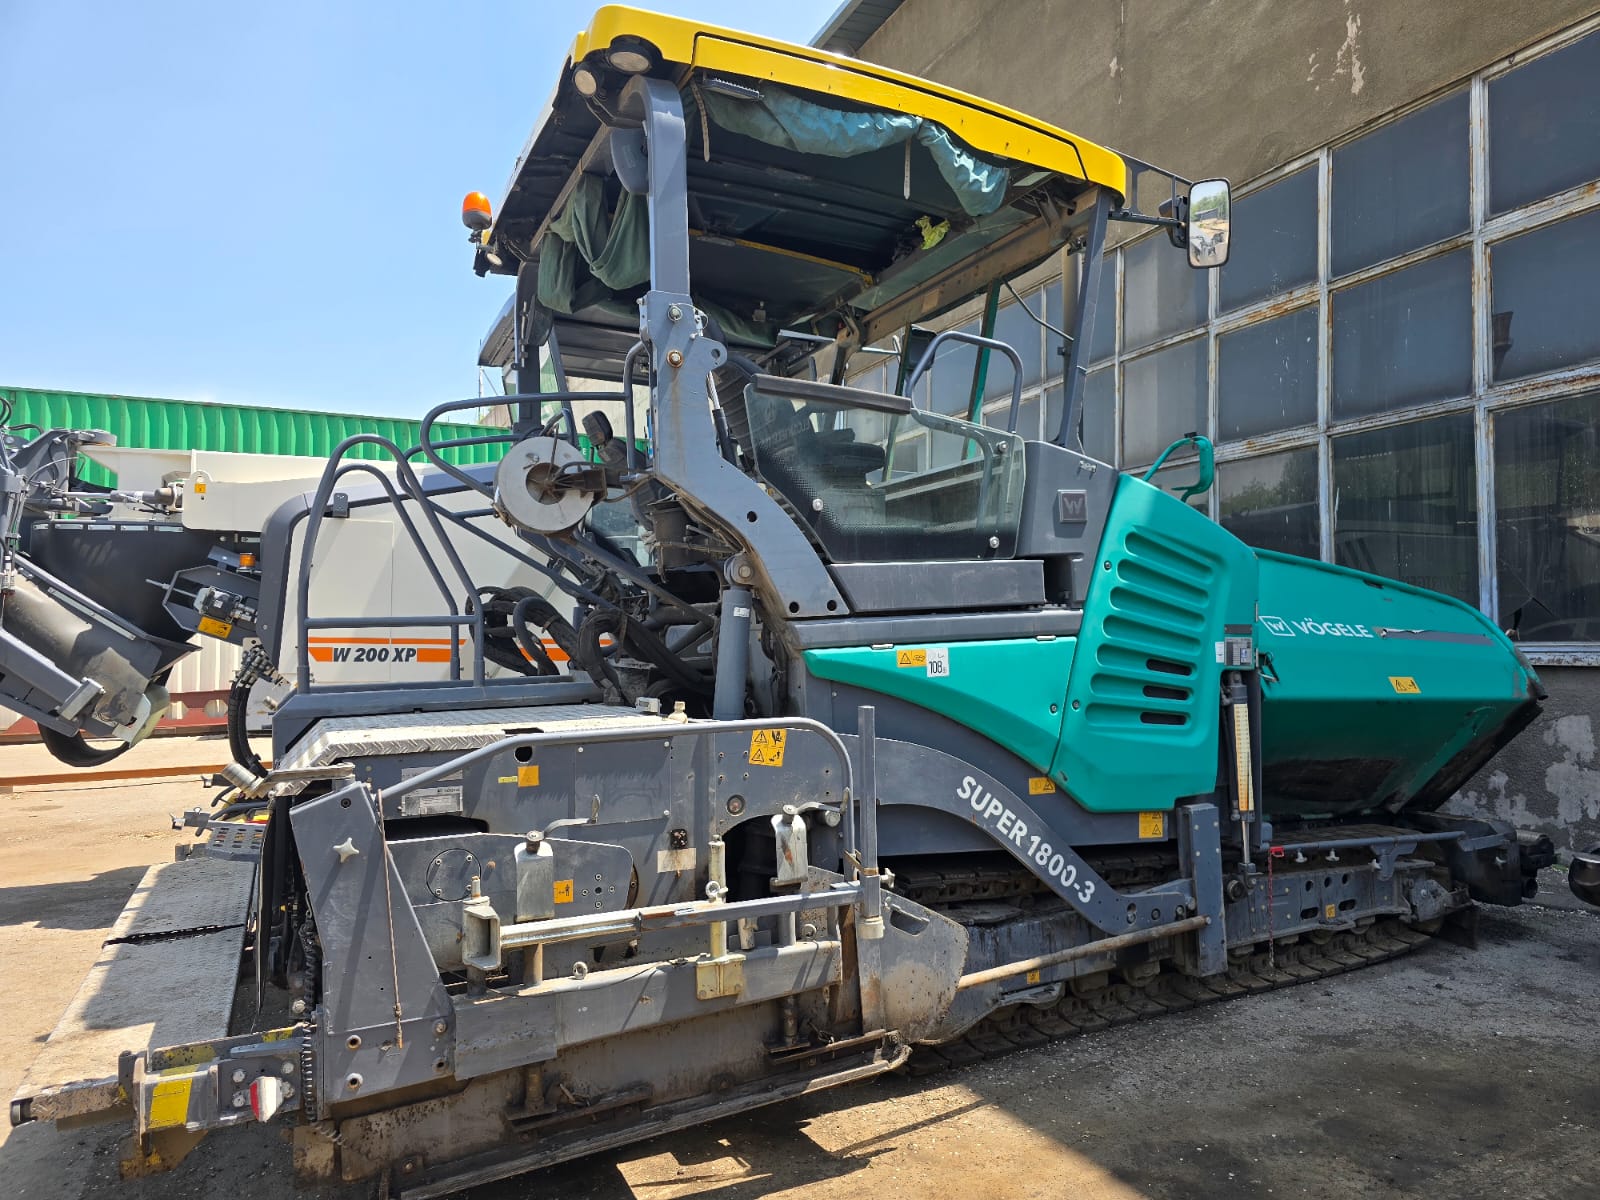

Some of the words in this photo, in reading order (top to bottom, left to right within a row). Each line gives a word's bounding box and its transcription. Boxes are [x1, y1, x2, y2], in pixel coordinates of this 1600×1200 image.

[1291, 617, 1374, 638] VÖGELE
[333, 647, 351, 662] W
[353, 647, 390, 662] 200
[392, 647, 416, 662] XP
[928, 660, 942, 675] 108
[956, 775, 1028, 847] SUPER
[1027, 835, 1096, 903] 1800-3
